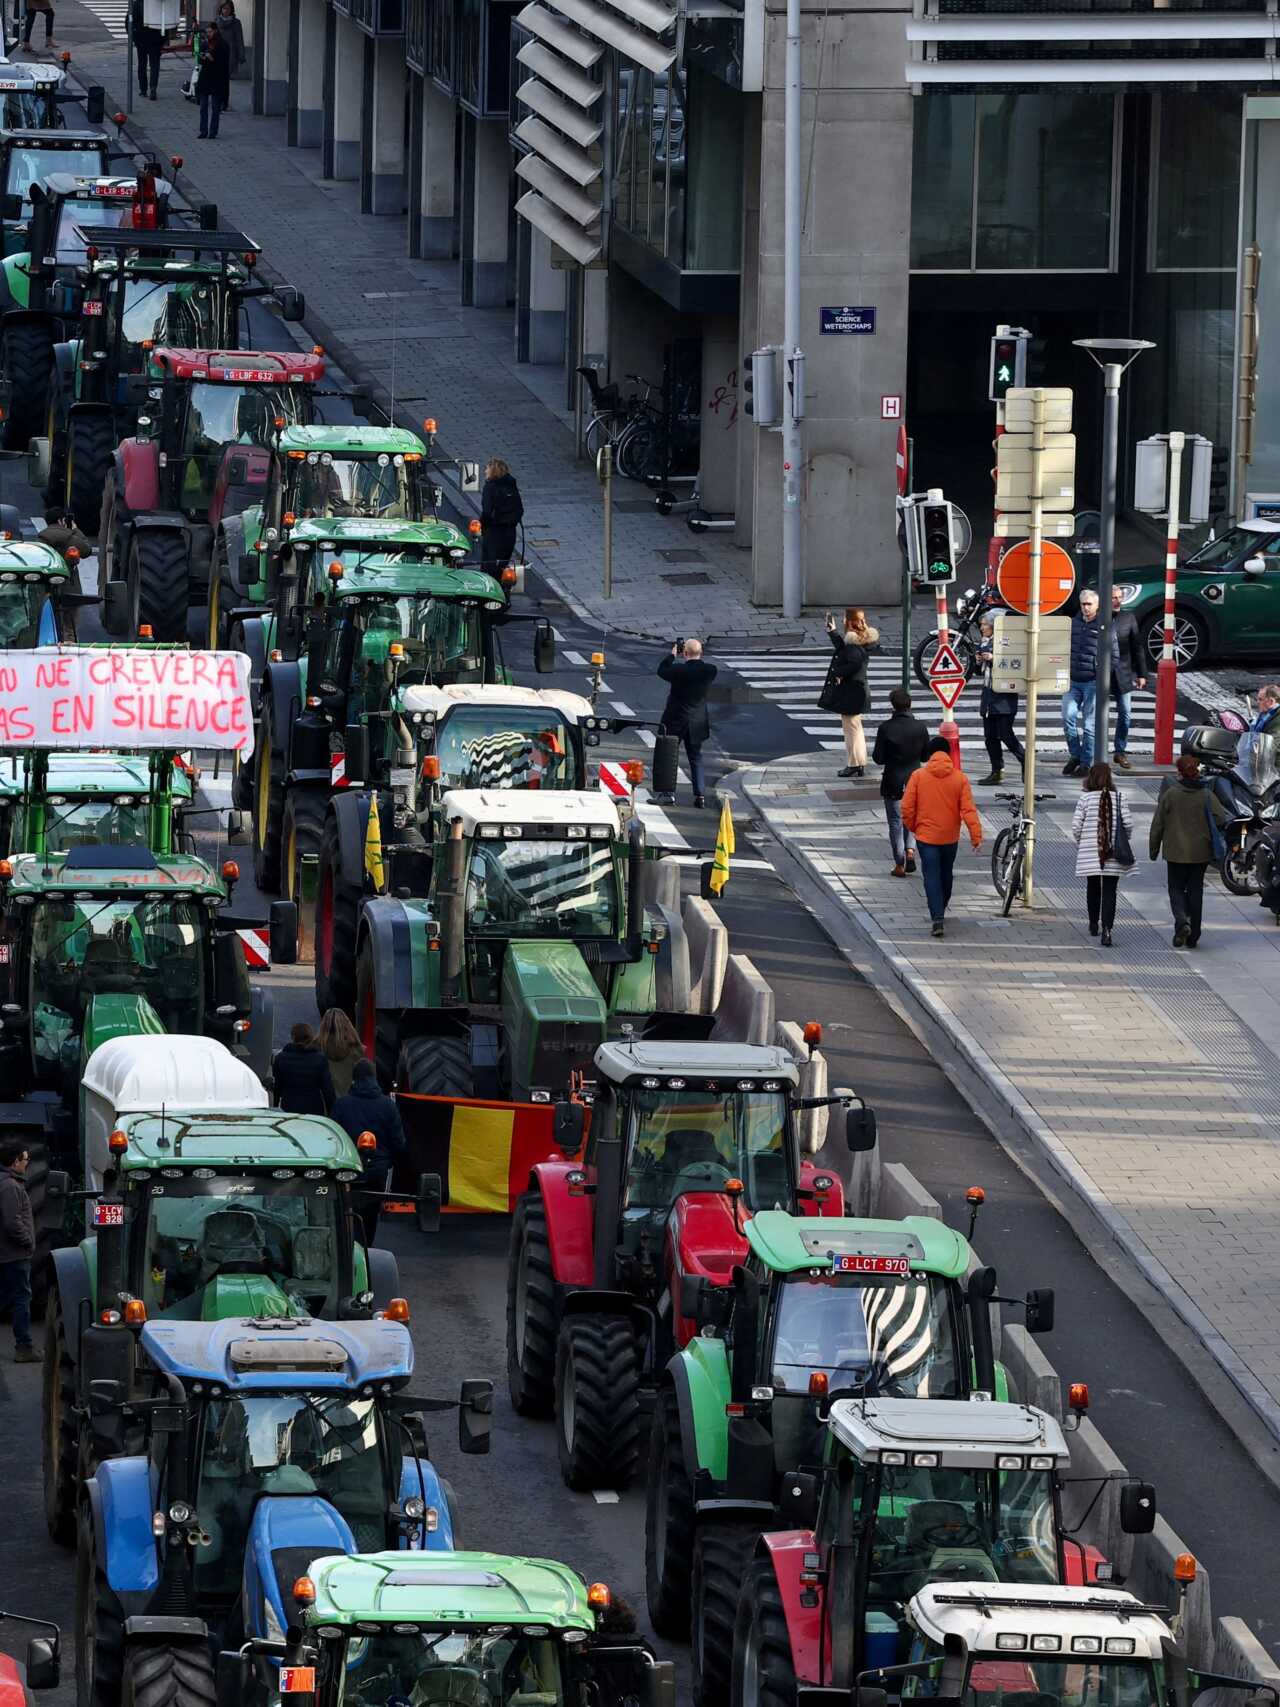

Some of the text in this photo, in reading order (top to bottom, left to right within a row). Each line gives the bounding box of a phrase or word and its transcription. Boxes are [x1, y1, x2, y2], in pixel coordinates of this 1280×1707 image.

[886, 400, 897, 415] H
[36, 658, 72, 688] NE
[89, 655, 237, 689] CREVERA
[52, 694, 94, 733] EN
[95, 1206, 122, 1214] G-LCV
[105, 1215, 122, 1223] 928
[841, 1258, 907, 1271] G-LCT-970
